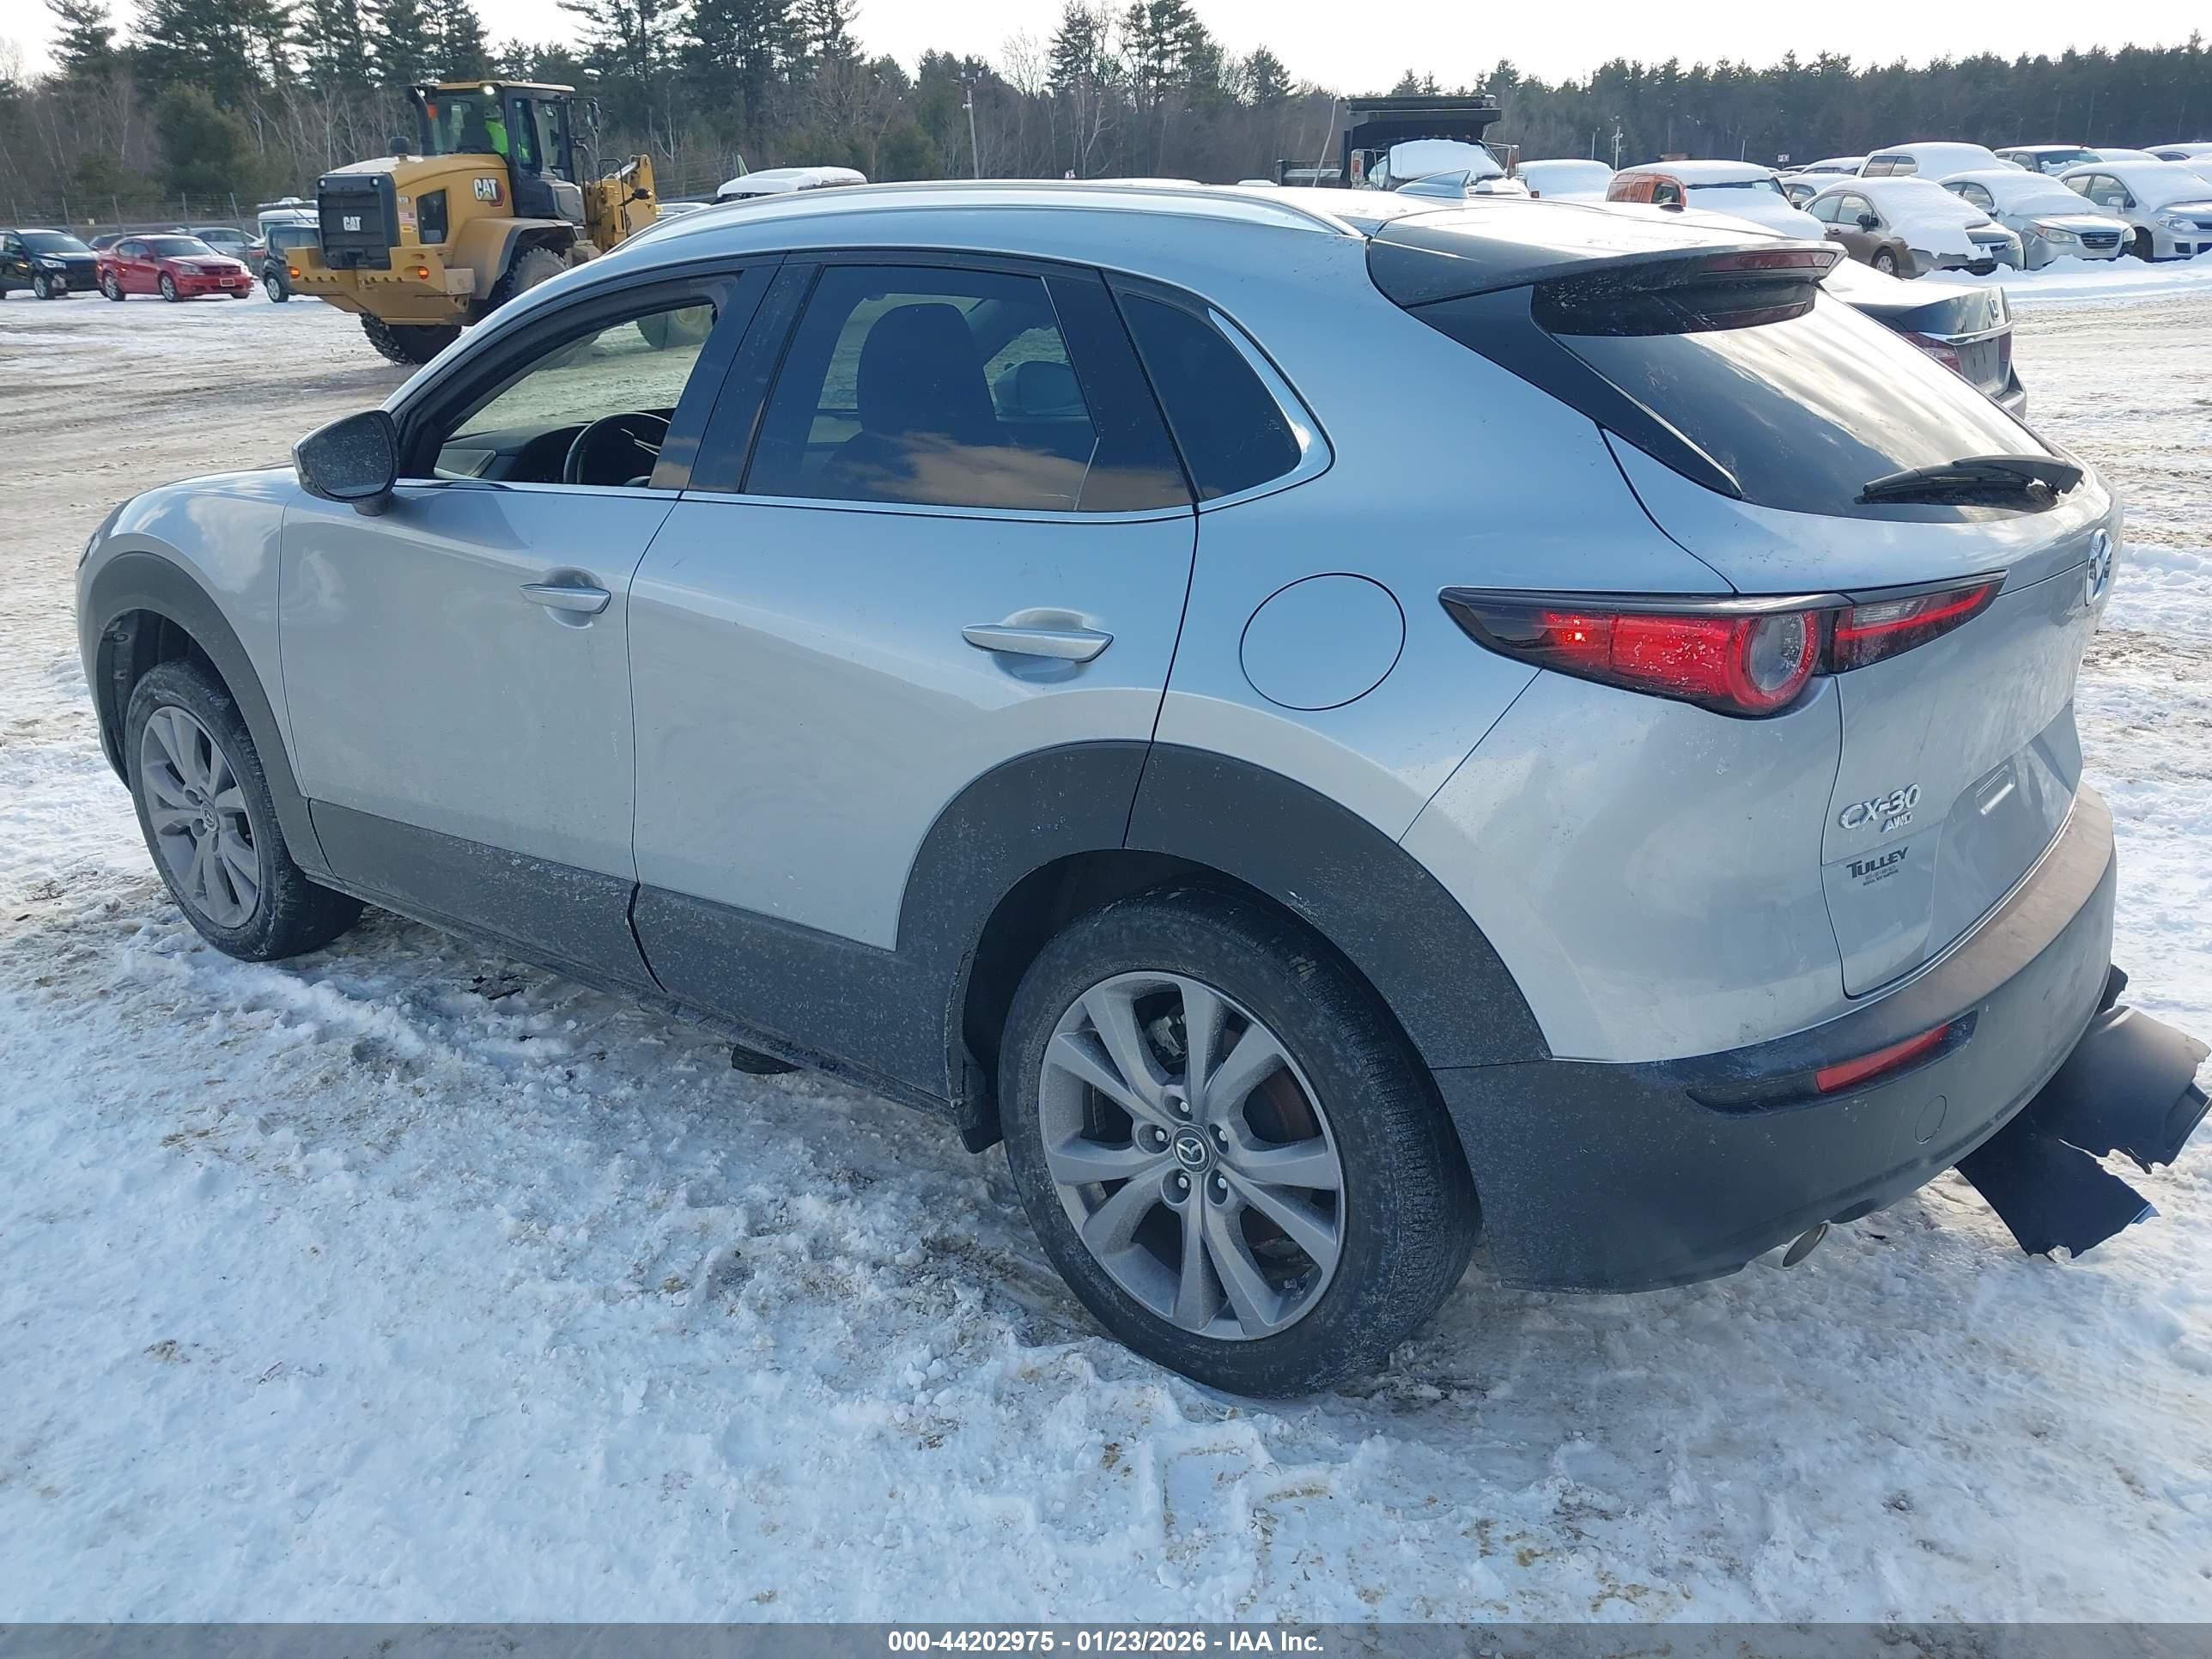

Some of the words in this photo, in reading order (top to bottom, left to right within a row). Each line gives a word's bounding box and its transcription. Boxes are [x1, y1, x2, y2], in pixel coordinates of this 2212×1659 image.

[473, 178, 497, 201] CAT
[343, 216, 362, 231] CAT
[1839, 783, 1922, 830] CX-30
[1881, 811, 1914, 833] AWD
[1846, 847, 1909, 878] TULLEY
